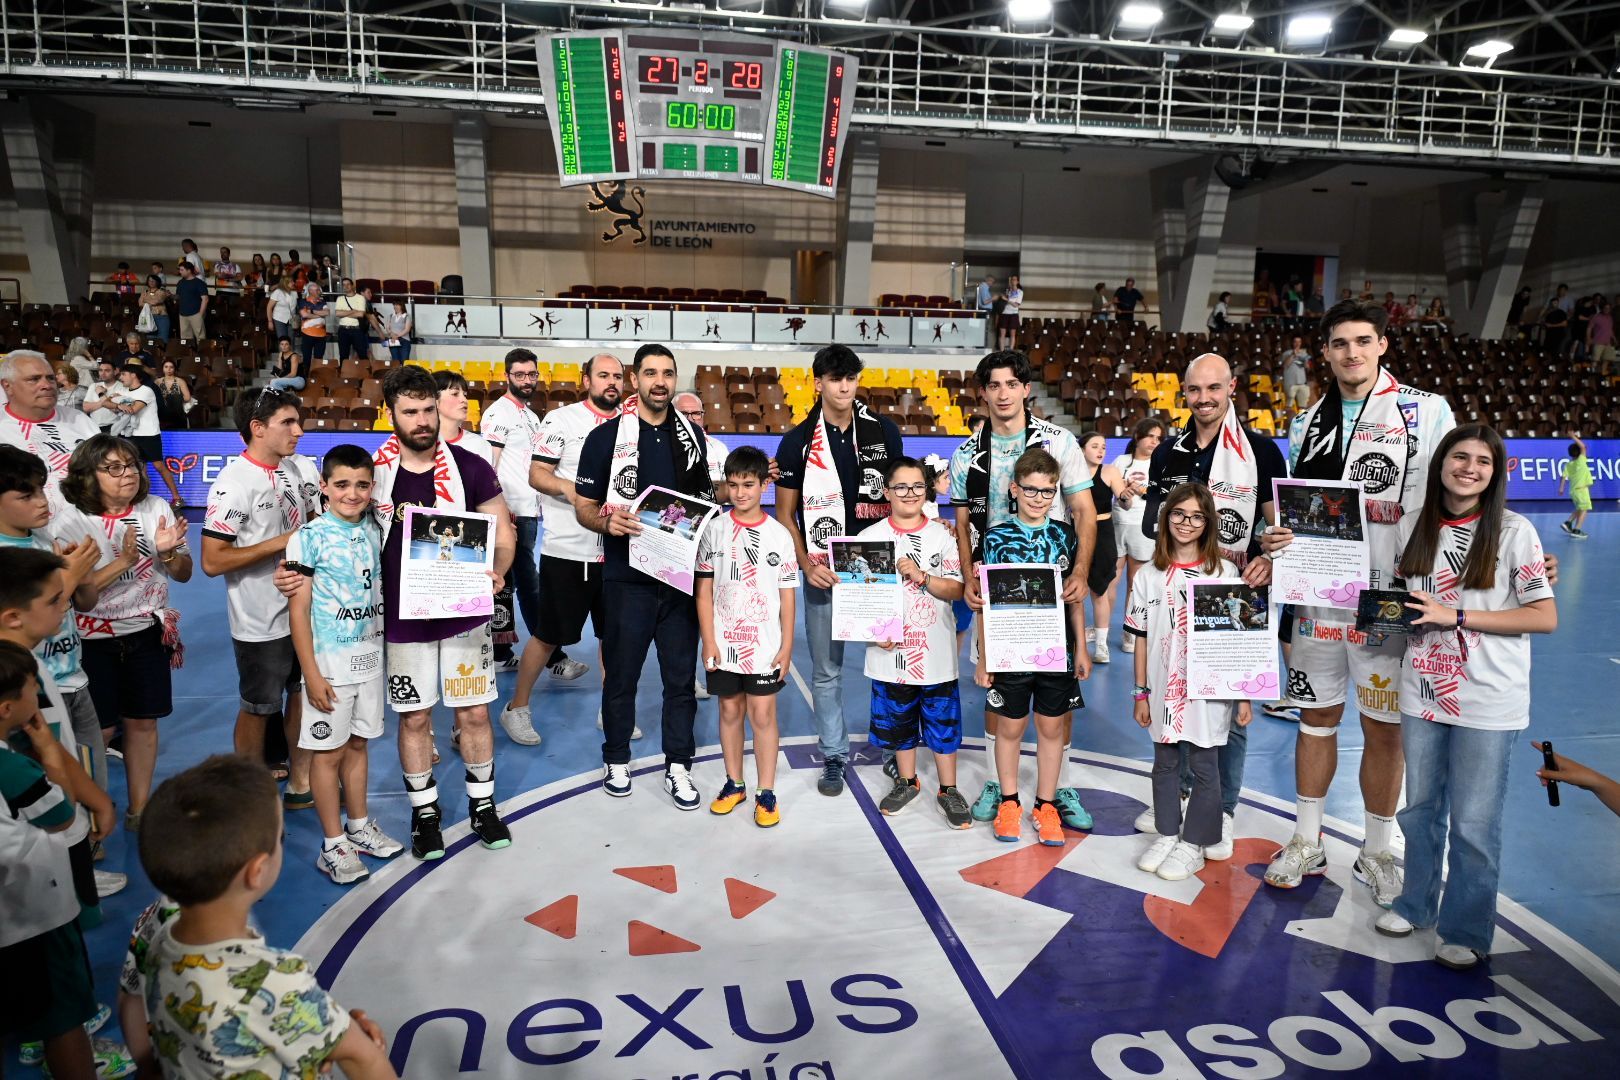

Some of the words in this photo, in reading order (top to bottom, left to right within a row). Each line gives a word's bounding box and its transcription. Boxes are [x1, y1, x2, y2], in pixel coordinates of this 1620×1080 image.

[648, 57, 677, 82] 27
[695, 62, 707, 82] 2
[732, 62, 760, 88] 28
[787, 60, 793, 70] 8
[563, 82, 568, 91] 8
[615, 90, 621, 100] 6
[668, 103, 734, 130] 60:00
[654, 221, 756, 234] AYUNTAMIENTO
[654, 236, 671, 247] DE
[676, 234, 712, 249] LEÓN
[1350, 462, 1398, 485] ADEMAR
[362, 569, 372, 589] 3
[734, 619, 759, 633] ZARPA
[1314, 621, 1342, 640] huevos
[724, 631, 760, 646] CAZURRA
[1428, 644, 1462, 664] ZARPA
[1412, 658, 1468, 681] CAZURRA
[444, 675, 486, 697] PICOPICO
[1357, 685, 1400, 712] PICOPIC
[388, 973, 919, 1078] nexus
[1090, 974, 1605, 1080] asobal
